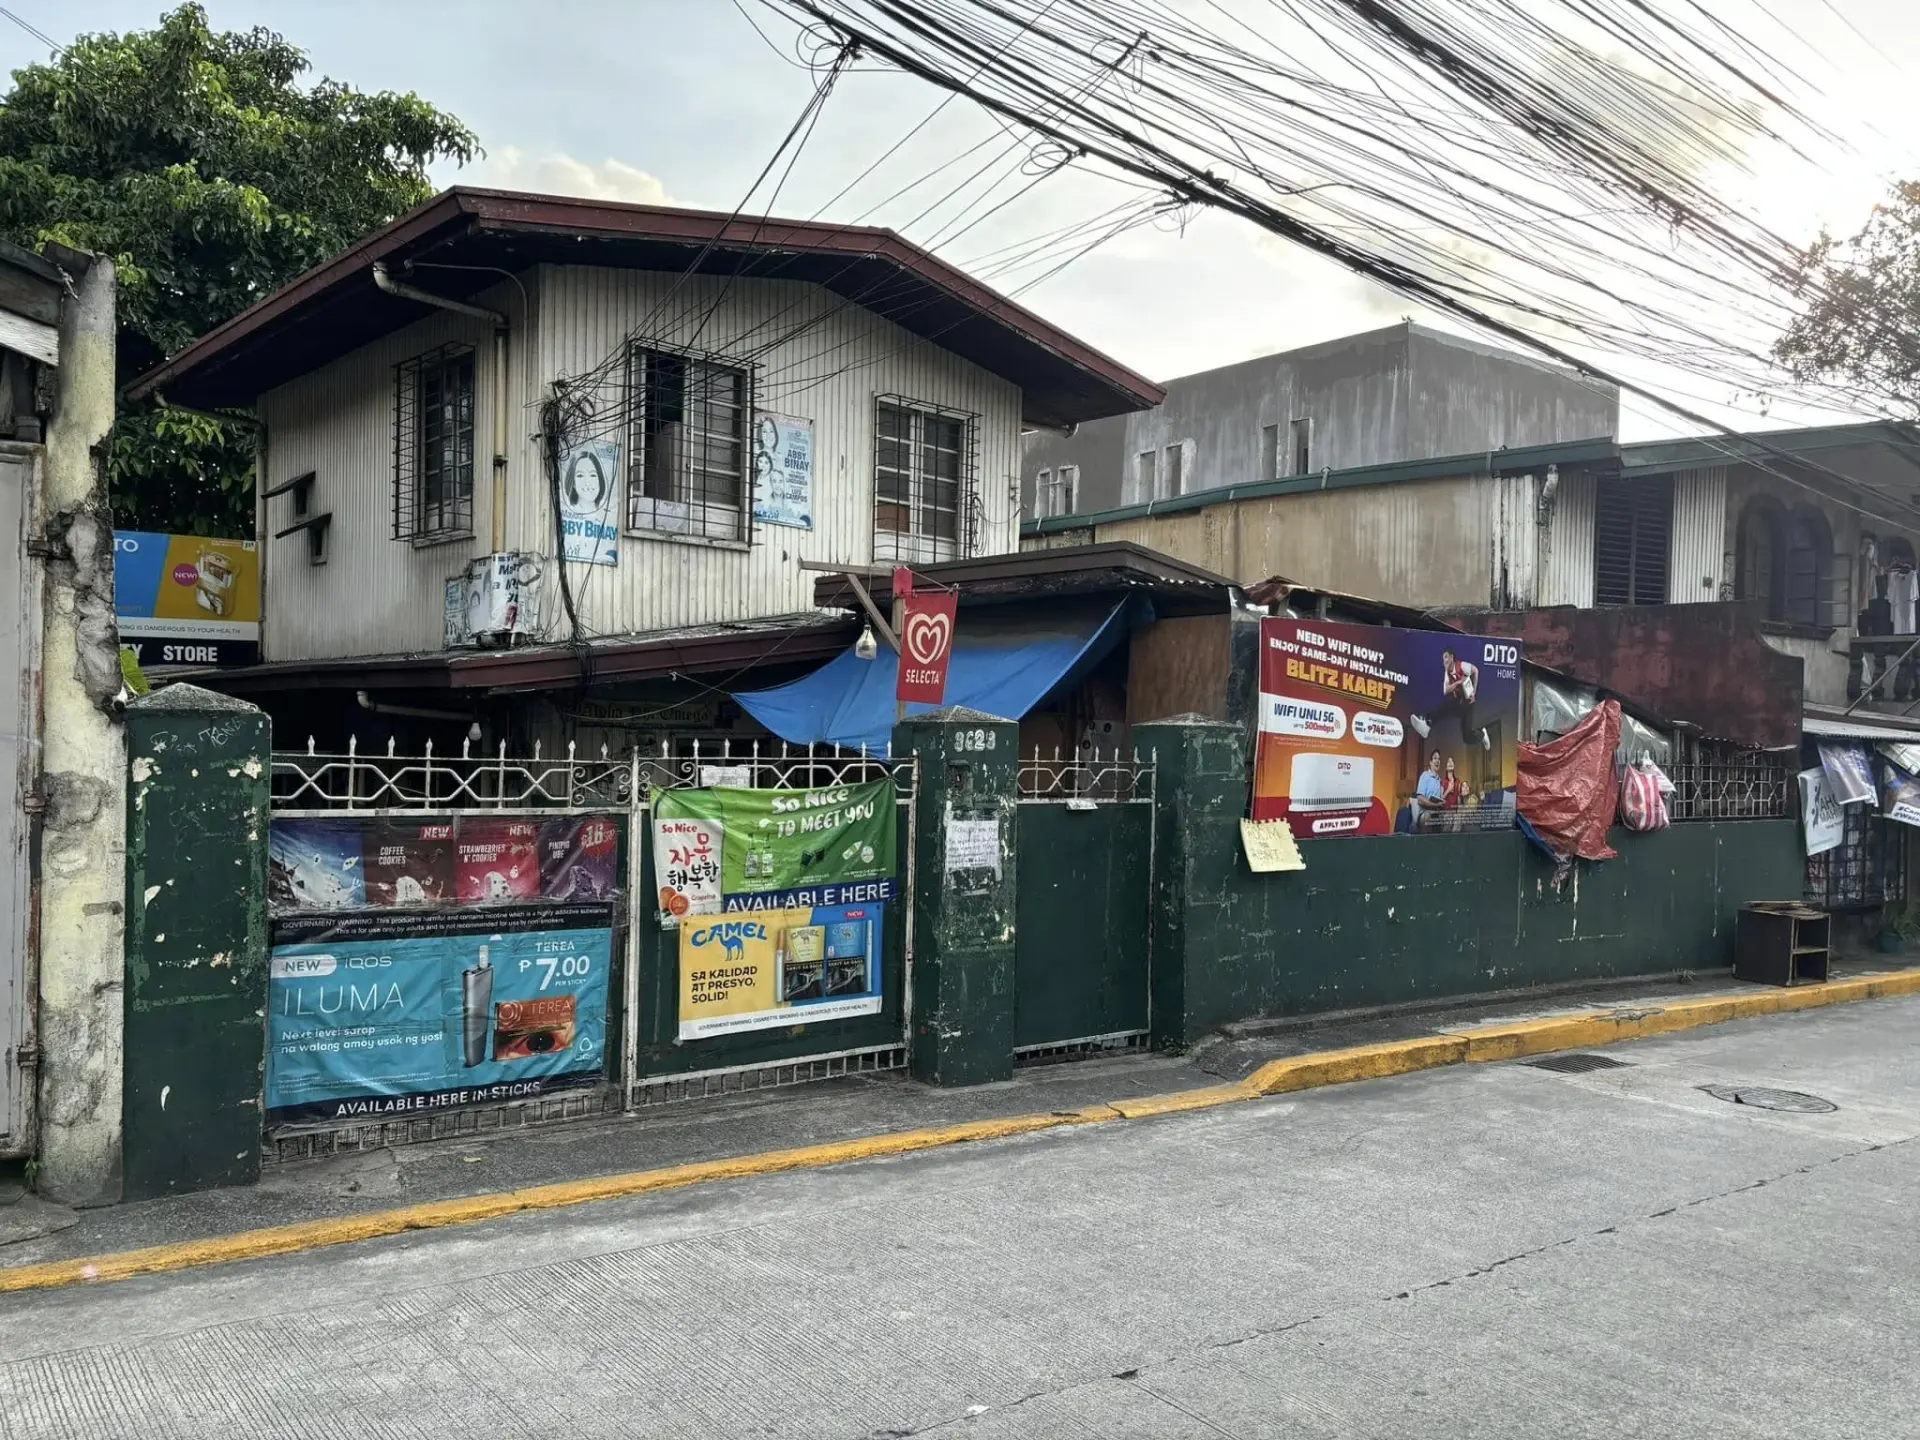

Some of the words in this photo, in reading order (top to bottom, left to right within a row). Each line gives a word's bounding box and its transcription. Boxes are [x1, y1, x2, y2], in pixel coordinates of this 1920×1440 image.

[788, 449, 806, 461] ABBY
[784, 457, 810, 472] BINAY
[562, 519, 583, 536] BBY
[163, 644, 218, 662] STORE
[1296, 628, 1326, 648] NEED
[1327, 637, 1352, 655] WIFI
[1353, 644, 1385, 664] NOW?
[1483, 643, 1518, 665] DITO
[1269, 637, 1301, 653] ENJOY
[1301, 646, 1349, 667] SAME-DAY
[1349, 659, 1410, 686] INSTALLATION
[905, 668, 940, 685] SELECTA
[1286, 658, 1339, 688] BLITZ
[1342, 672, 1396, 702] KABIT
[1496, 668, 1516, 680] HOME
[1274, 703, 1298, 718] WIFI
[1299, 707, 1322, 721] UNLI
[1322, 711, 1335, 723] 5G
[1304, 720, 1335, 733] 500mbps
[1337, 762, 1352, 770] DITO
[770, 796, 801, 815] So
[804, 787, 849, 809] Nice
[776, 819, 797, 839] TO
[801, 809, 842, 834] MEET
[845, 801, 875, 824] YOU
[1319, 820, 1338, 830] APPLY
[1340, 819, 1356, 828] NOW!
[423, 826, 450, 839] NEW
[509, 824, 533, 837] NEW
[661, 824, 674, 834] So
[674, 823, 698, 834] Nice
[380, 846, 405, 856] COFFEE
[458, 843, 506, 854] STRAWBERRIES
[378, 856, 406, 866] COOKIES
[471, 853, 497, 863] COOKIES
[726, 888, 836, 914] AVAILABLE
[841, 882, 891, 904] HERE
[282, 919, 336, 930] GOVERNMENT
[459, 913, 484, 921] contains
[537, 909, 554, 917] highly
[555, 908, 579, 916] addictive
[847, 910, 864, 918] NEW
[456, 921, 499, 929] recommended
[691, 921, 768, 947] CAMEL
[535, 940, 576, 953] TEREA
[285, 959, 321, 973] NEW
[344, 955, 393, 970] IQOS
[691, 970, 706, 982] SA
[709, 966, 758, 979] KALIDAD
[691, 982, 706, 993] AT
[708, 977, 756, 991] PRESYO,
[285, 981, 405, 1017] ILUMA
[691, 991, 729, 1004] SOLID!
[531, 999, 573, 1015] TEREA
[282, 1030, 313, 1041] Next
[314, 1027, 342, 1038] level
[343, 1026, 376, 1039] sarap
[281, 1046, 297, 1054] na
[299, 1041, 341, 1053] walang
[343, 1038, 375, 1050] amoy
[377, 1034, 403, 1046] usok
[405, 1036, 418, 1046] ng
[421, 1030, 443, 1045] yosi
[336, 1096, 425, 1117] AVAILABLE
[429, 1091, 469, 1107] HERE
[472, 1088, 487, 1101] IN
[491, 1081, 541, 1099] STICKS
